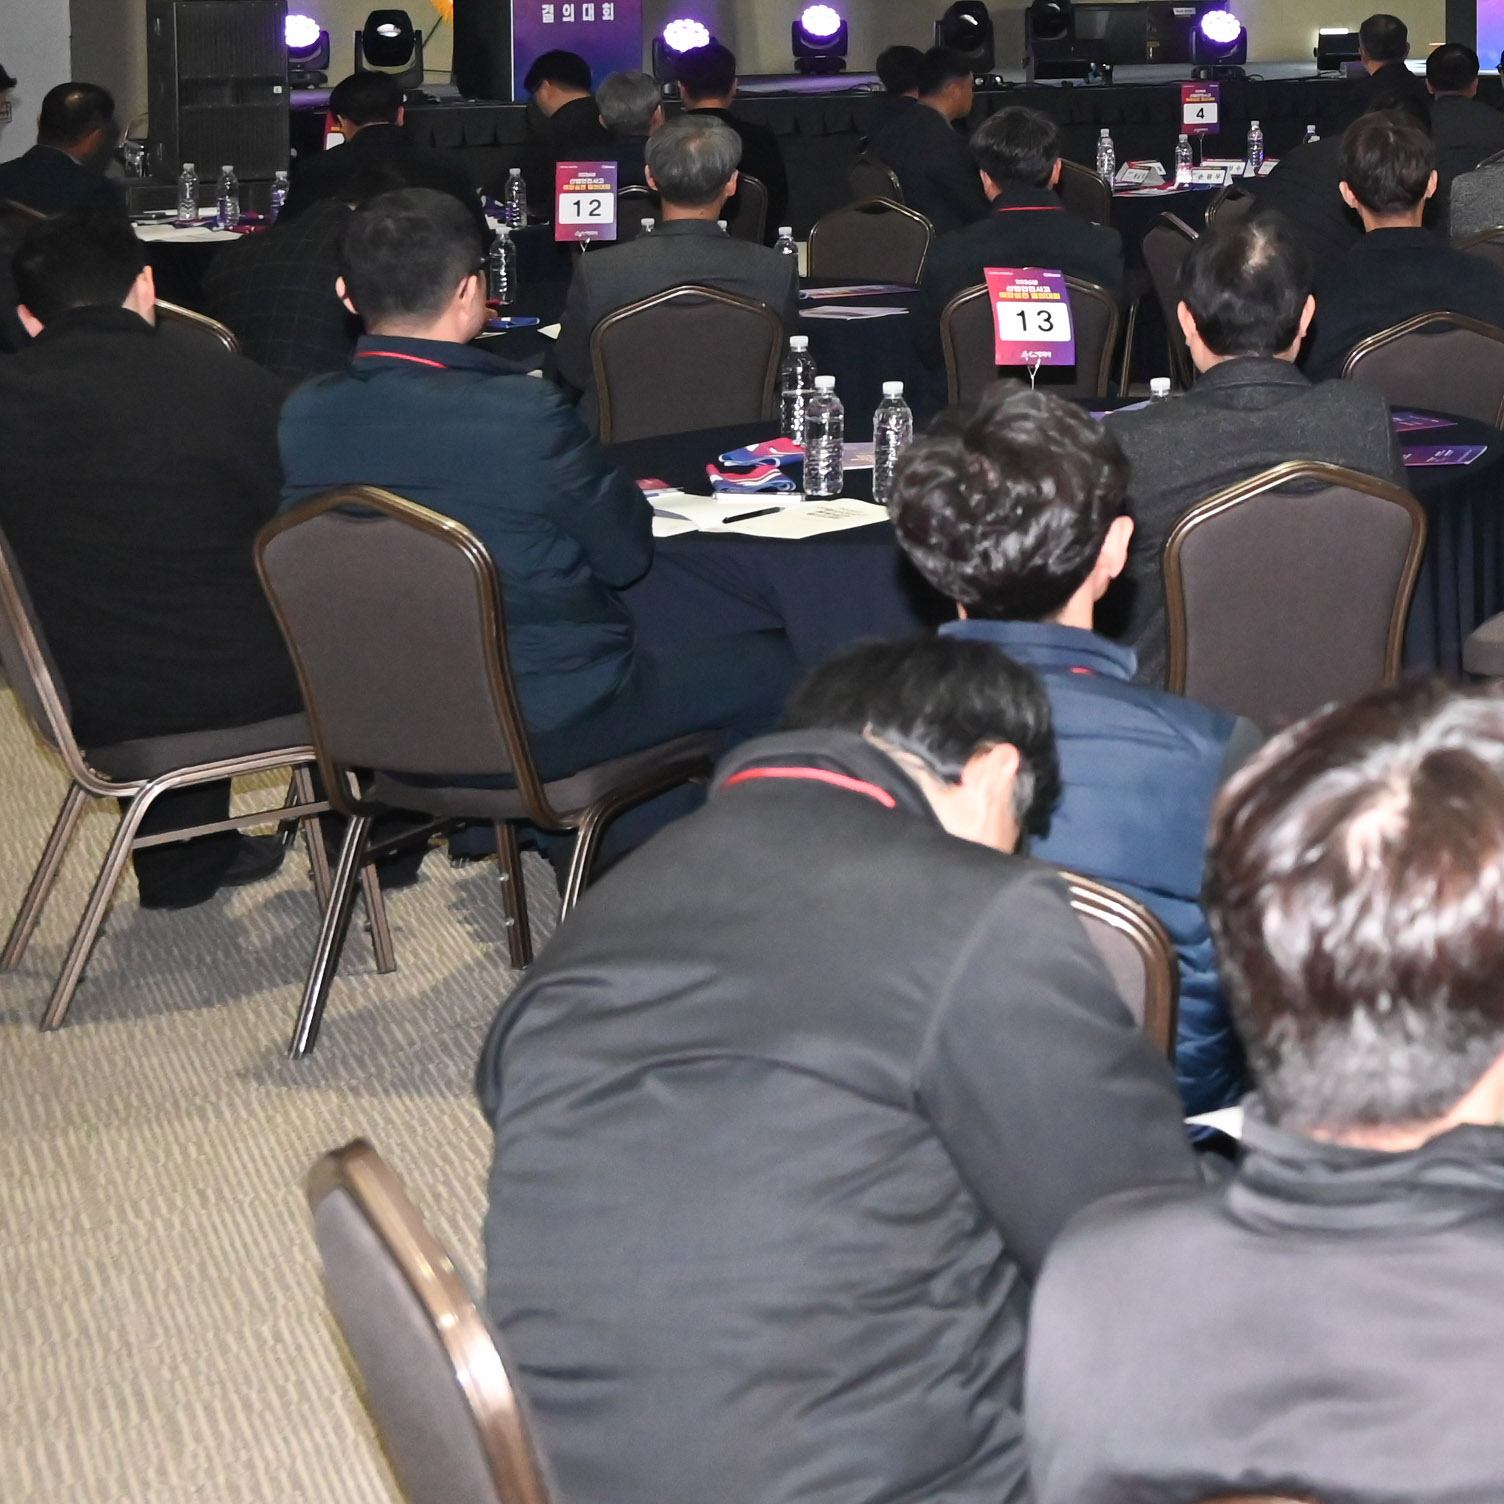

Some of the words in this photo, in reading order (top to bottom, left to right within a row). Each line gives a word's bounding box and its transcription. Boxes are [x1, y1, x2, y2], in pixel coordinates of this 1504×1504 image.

[1196, 107, 1205, 119] 4
[573, 199, 601, 217] 12
[1016, 310, 1054, 332] 13
